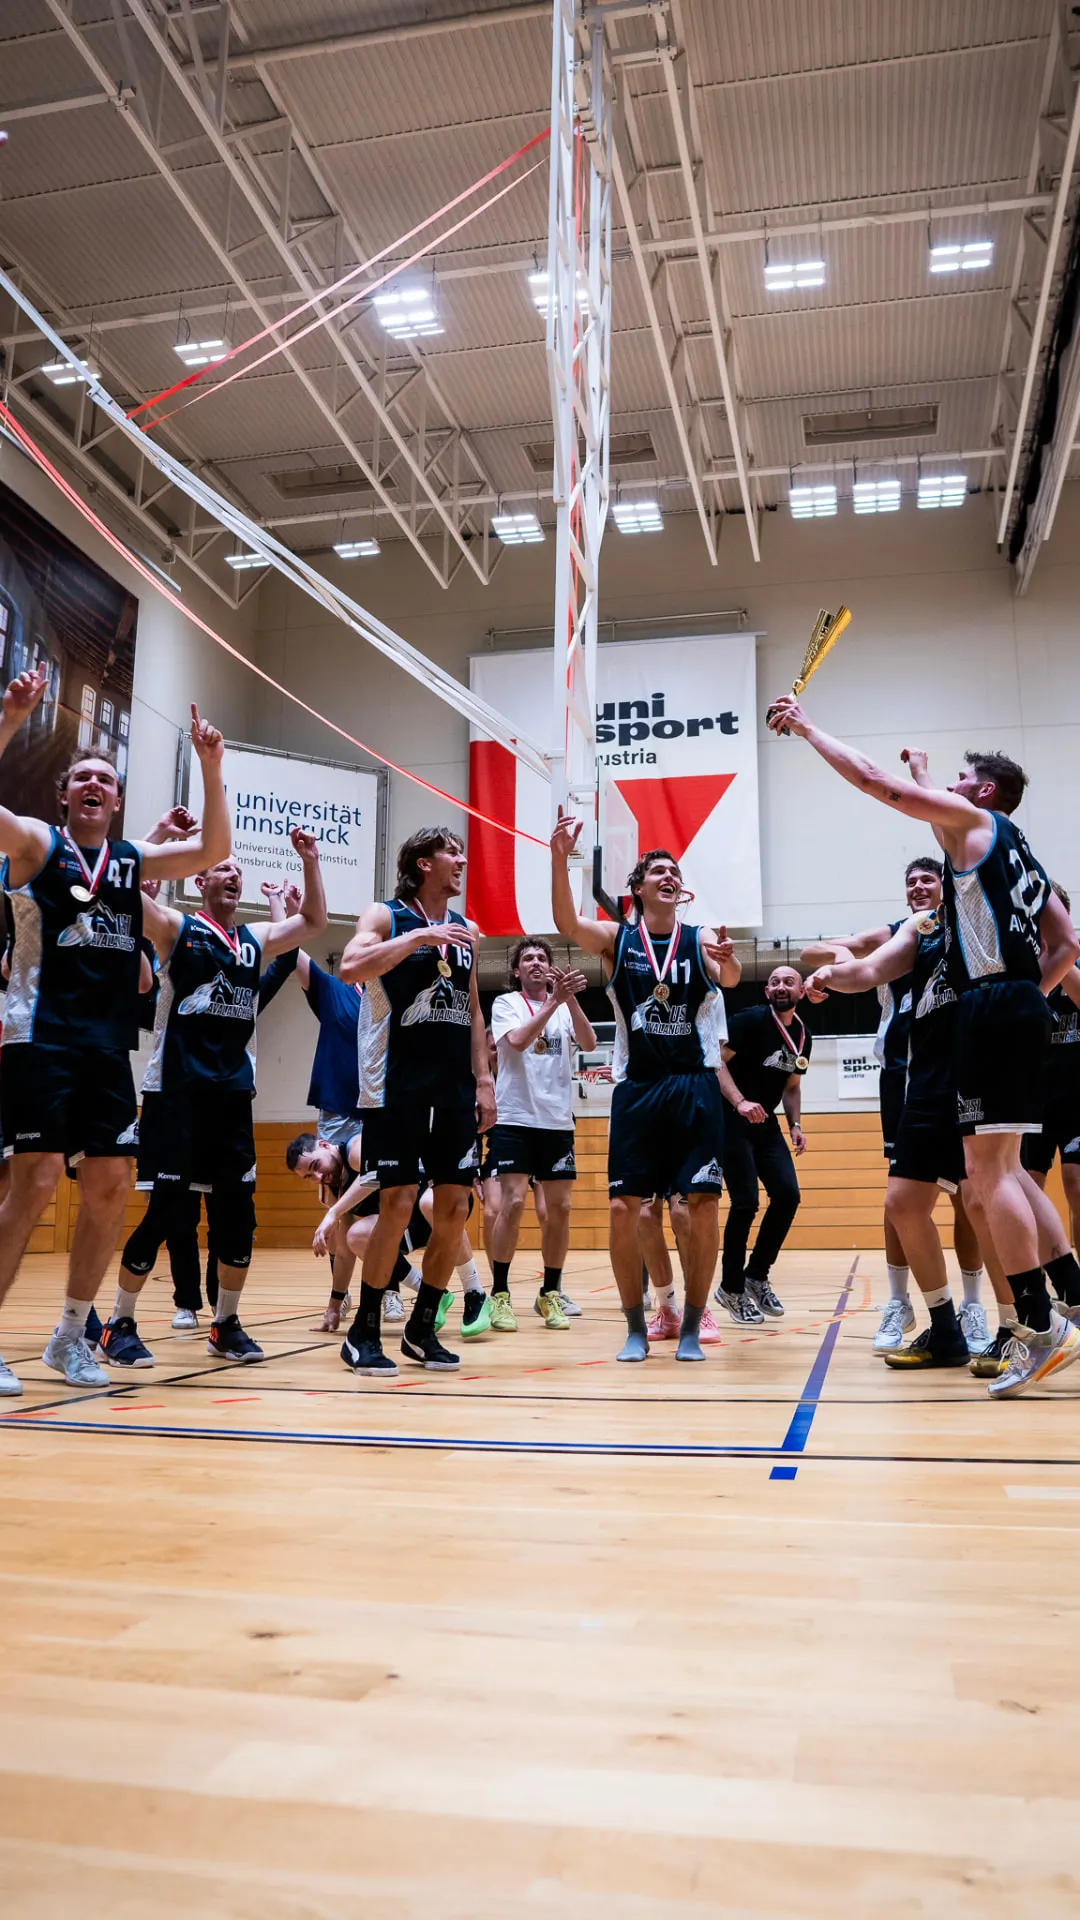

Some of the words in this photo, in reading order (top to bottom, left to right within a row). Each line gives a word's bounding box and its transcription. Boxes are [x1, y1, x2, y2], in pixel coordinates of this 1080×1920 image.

[596, 692, 665, 722] uni
[596, 711, 739, 746] sport
[596, 748, 657, 767] ustria
[237, 792, 362, 827] universität
[233, 853, 283, 870] nnsbruck
[285, 861, 302, 872] (US
[234, 840, 358, 867] Universitäts-tinstitut
[107, 858, 136, 889] 47
[452, 942, 472, 971] 15
[670, 958, 691, 985] 11
[232, 986, 253, 1008] US
[842, 1056, 867, 1065] uni
[843, 1064, 880, 1073] spor
